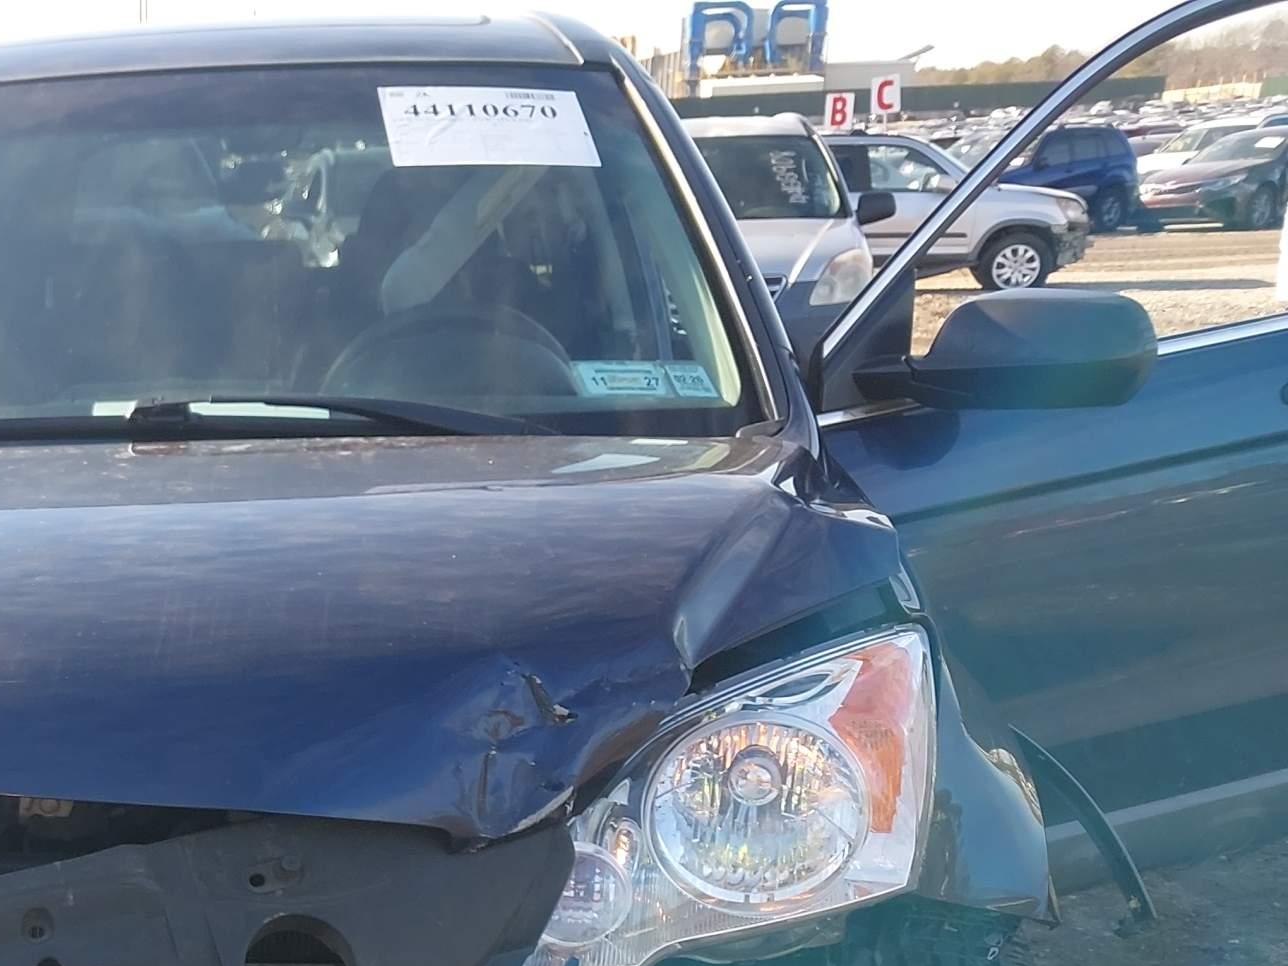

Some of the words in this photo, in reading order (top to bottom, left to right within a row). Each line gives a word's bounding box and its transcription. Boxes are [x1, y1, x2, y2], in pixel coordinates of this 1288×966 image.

[876, 79, 894, 110] C
[403, 103, 558, 119] 44110670
[830, 96, 847, 126] B
